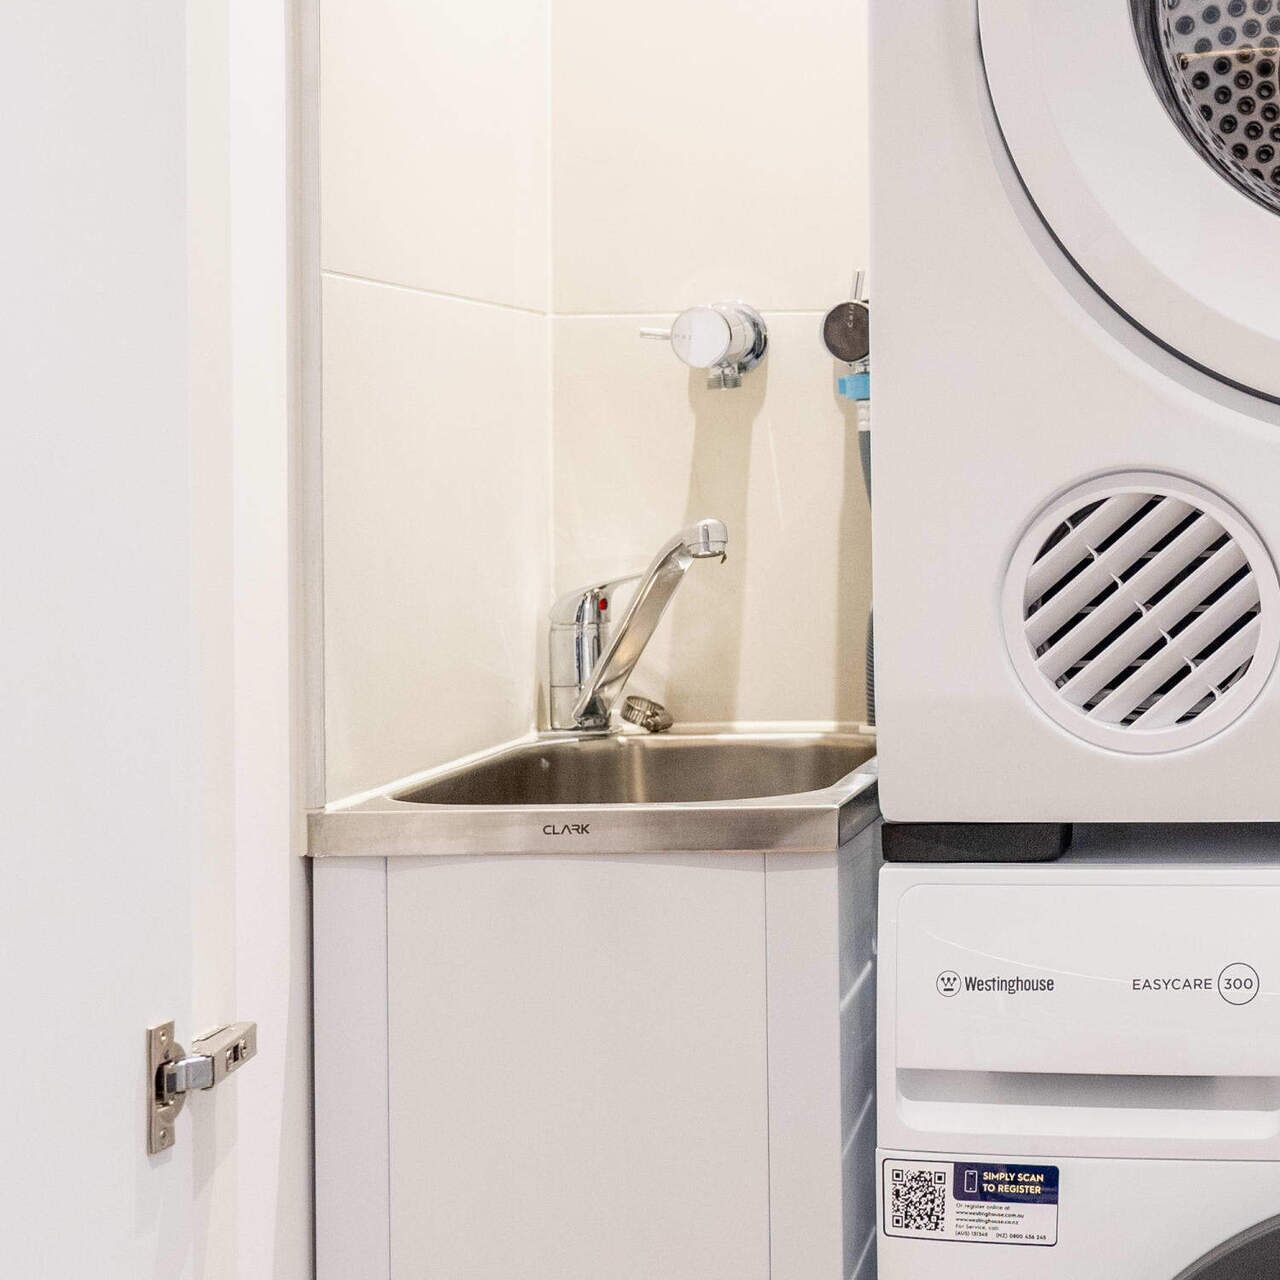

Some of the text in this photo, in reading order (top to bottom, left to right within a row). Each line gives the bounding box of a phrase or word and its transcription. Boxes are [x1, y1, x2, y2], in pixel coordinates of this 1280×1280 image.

[542, 823, 591, 835] CLARK
[964, 976, 1055, 995] Westinghouse
[1132, 978, 1254, 990] EASYCARE 300
[982, 1171, 1044, 1183] SIMPLY SCAN
[982, 1183, 1041, 1194] TO REGISTER
